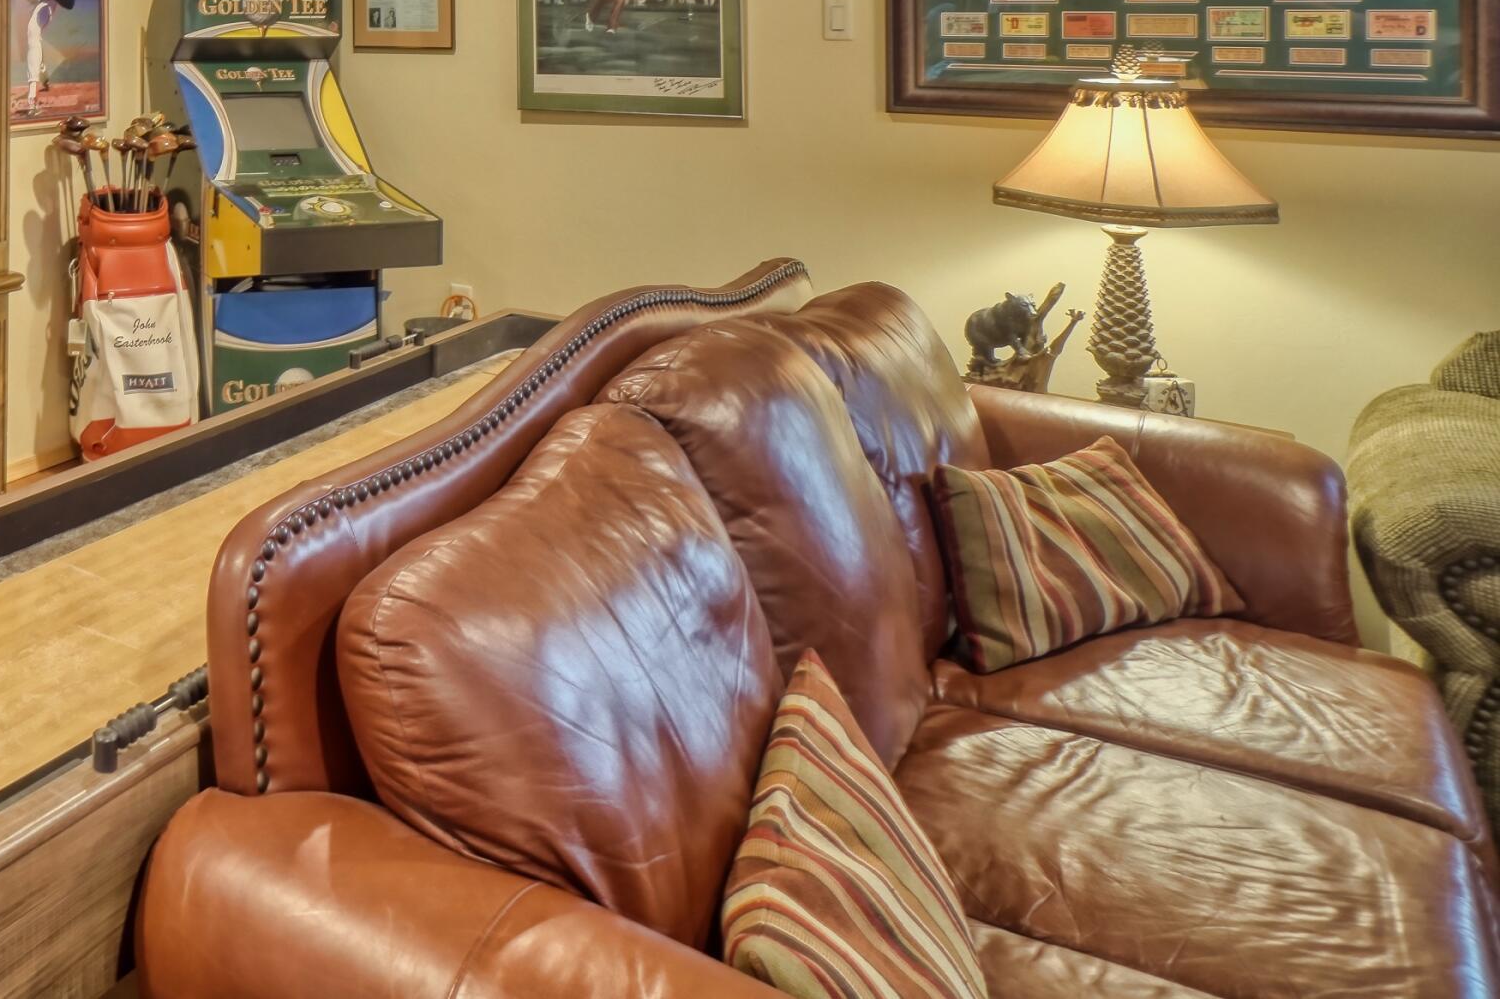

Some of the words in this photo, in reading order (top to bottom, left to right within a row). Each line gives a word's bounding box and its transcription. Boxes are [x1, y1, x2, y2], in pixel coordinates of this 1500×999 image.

[132, 318, 156, 334] John
[113, 332, 173, 348] Easterbrook
[129, 376, 167, 388] HYATT
